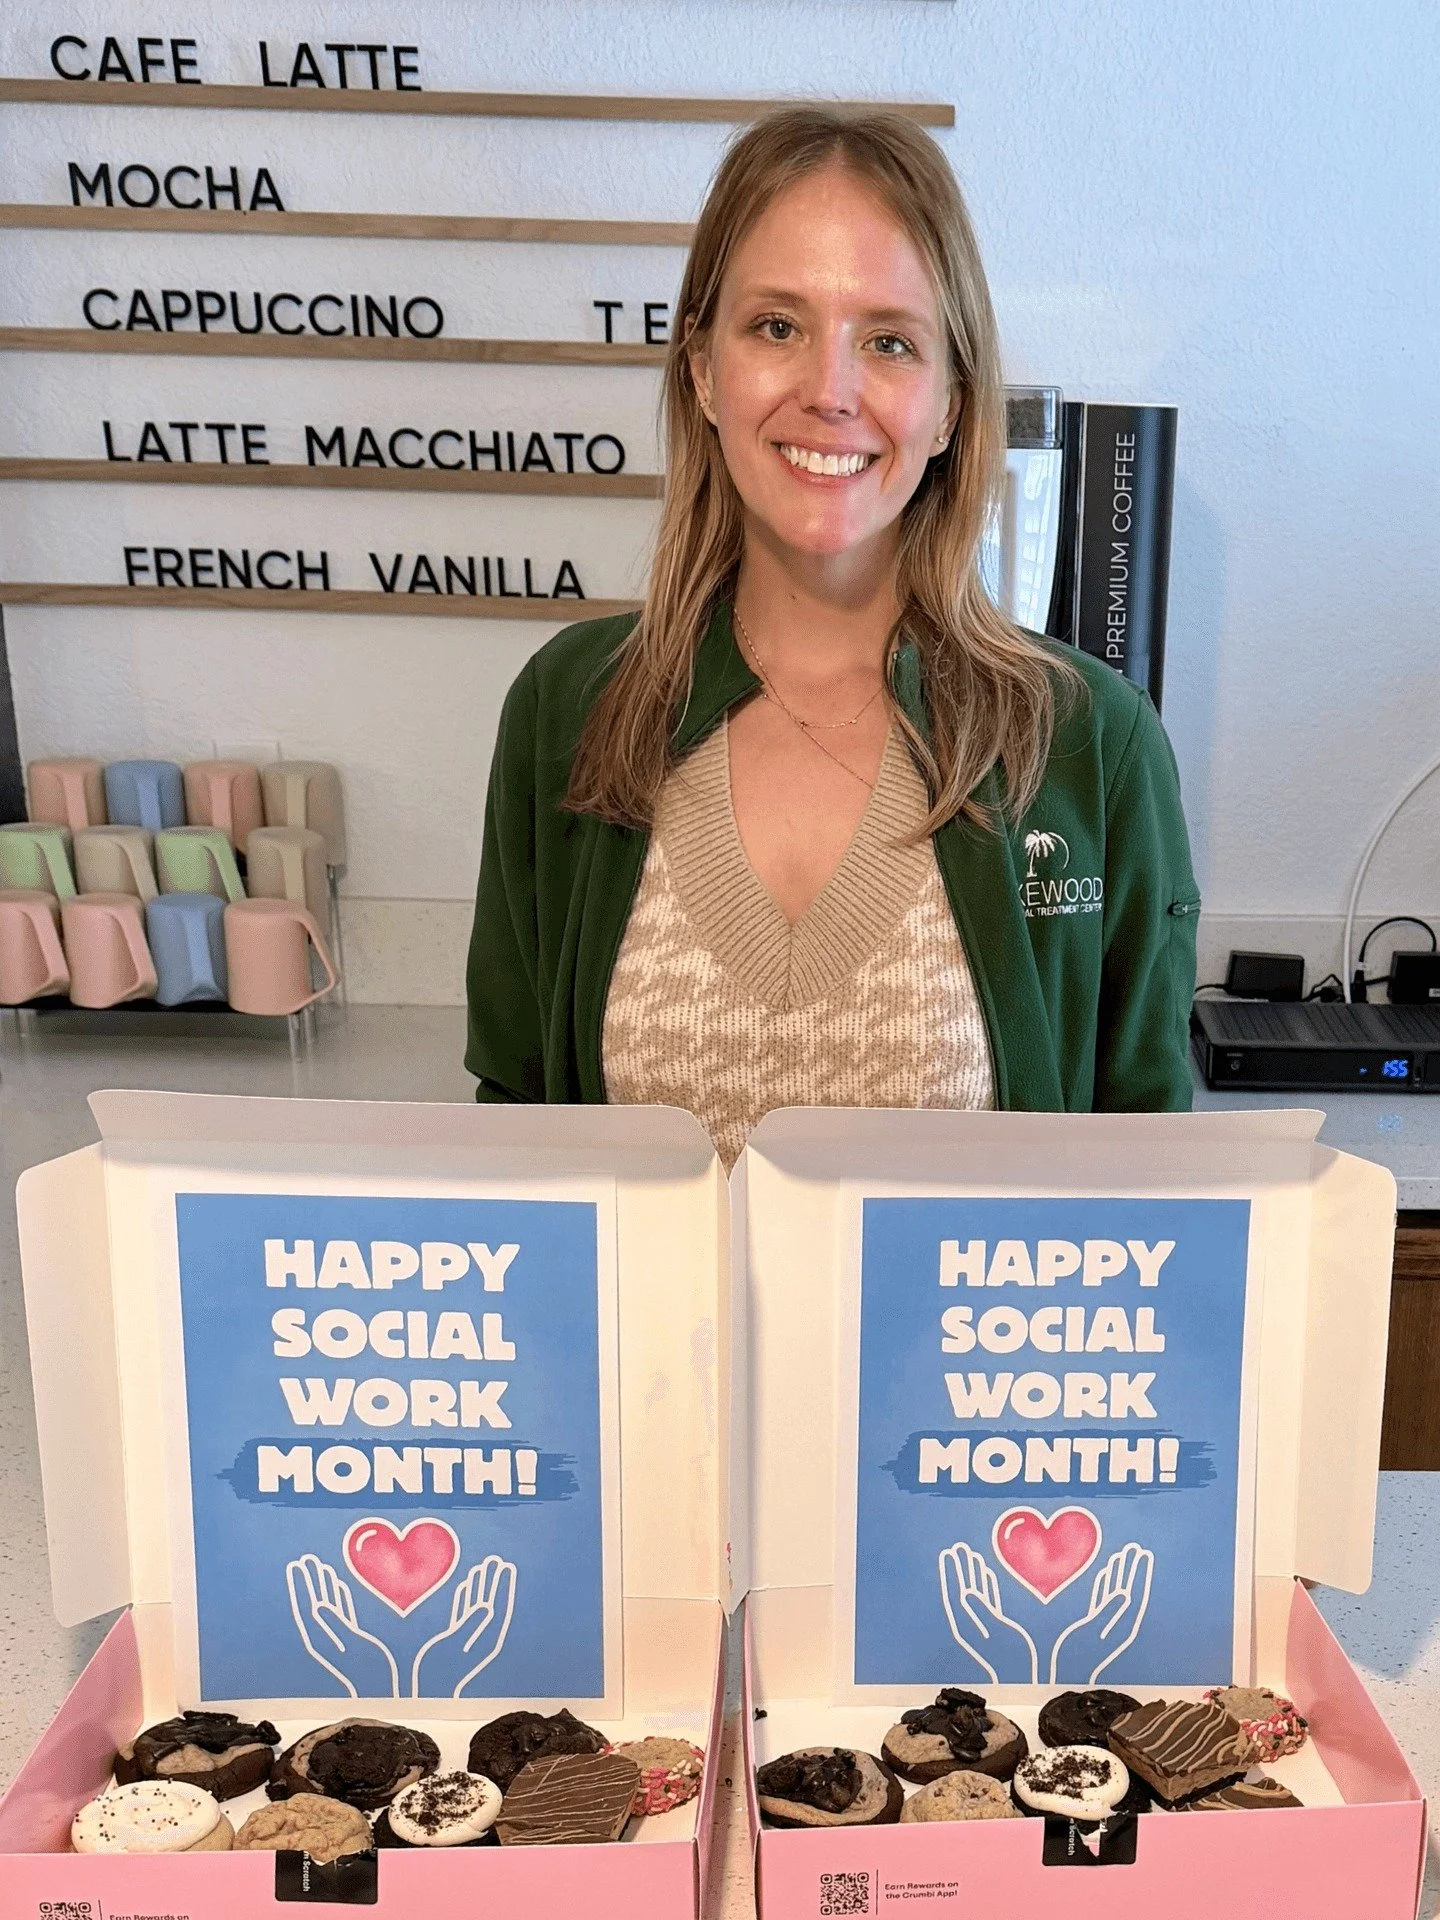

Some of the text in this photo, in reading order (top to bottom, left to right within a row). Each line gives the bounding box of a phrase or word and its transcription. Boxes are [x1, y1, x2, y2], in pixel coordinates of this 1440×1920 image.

[50, 36, 422, 91] CAFE LATTE
[68, 162, 286, 211] MOCHA
[82, 289, 669, 345] CAPPUCCINO TE
[103, 421, 626, 474] LATTE MACCHIATO
[1112, 432, 1135, 533] COFFEE
[123, 547, 586, 600] FRENCH VANILLA
[1106, 542, 1129, 659] PREMIUM
[1018, 877, 1103, 906] KEWOOD
[1025, 908, 1035, 917] AL
[1037, 904, 1079, 916] TREATMENT
[264, 1238, 520, 1292] HAPPY
[939, 1240, 1176, 1287] HAPPY
[271, 1308, 516, 1361] SOCIAL
[941, 1306, 1165, 1353] SOCIAL
[279, 1377, 512, 1428] WORK
[944, 1371, 1157, 1418] WORK
[257, 1445, 538, 1495] MONTH!
[919, 1437, 1180, 1484] MONTH!
[302, 1860, 311, 1892] Scratch
[884, 1883, 906, 1891] Earn
[907, 1882, 946, 1890] Rewards
